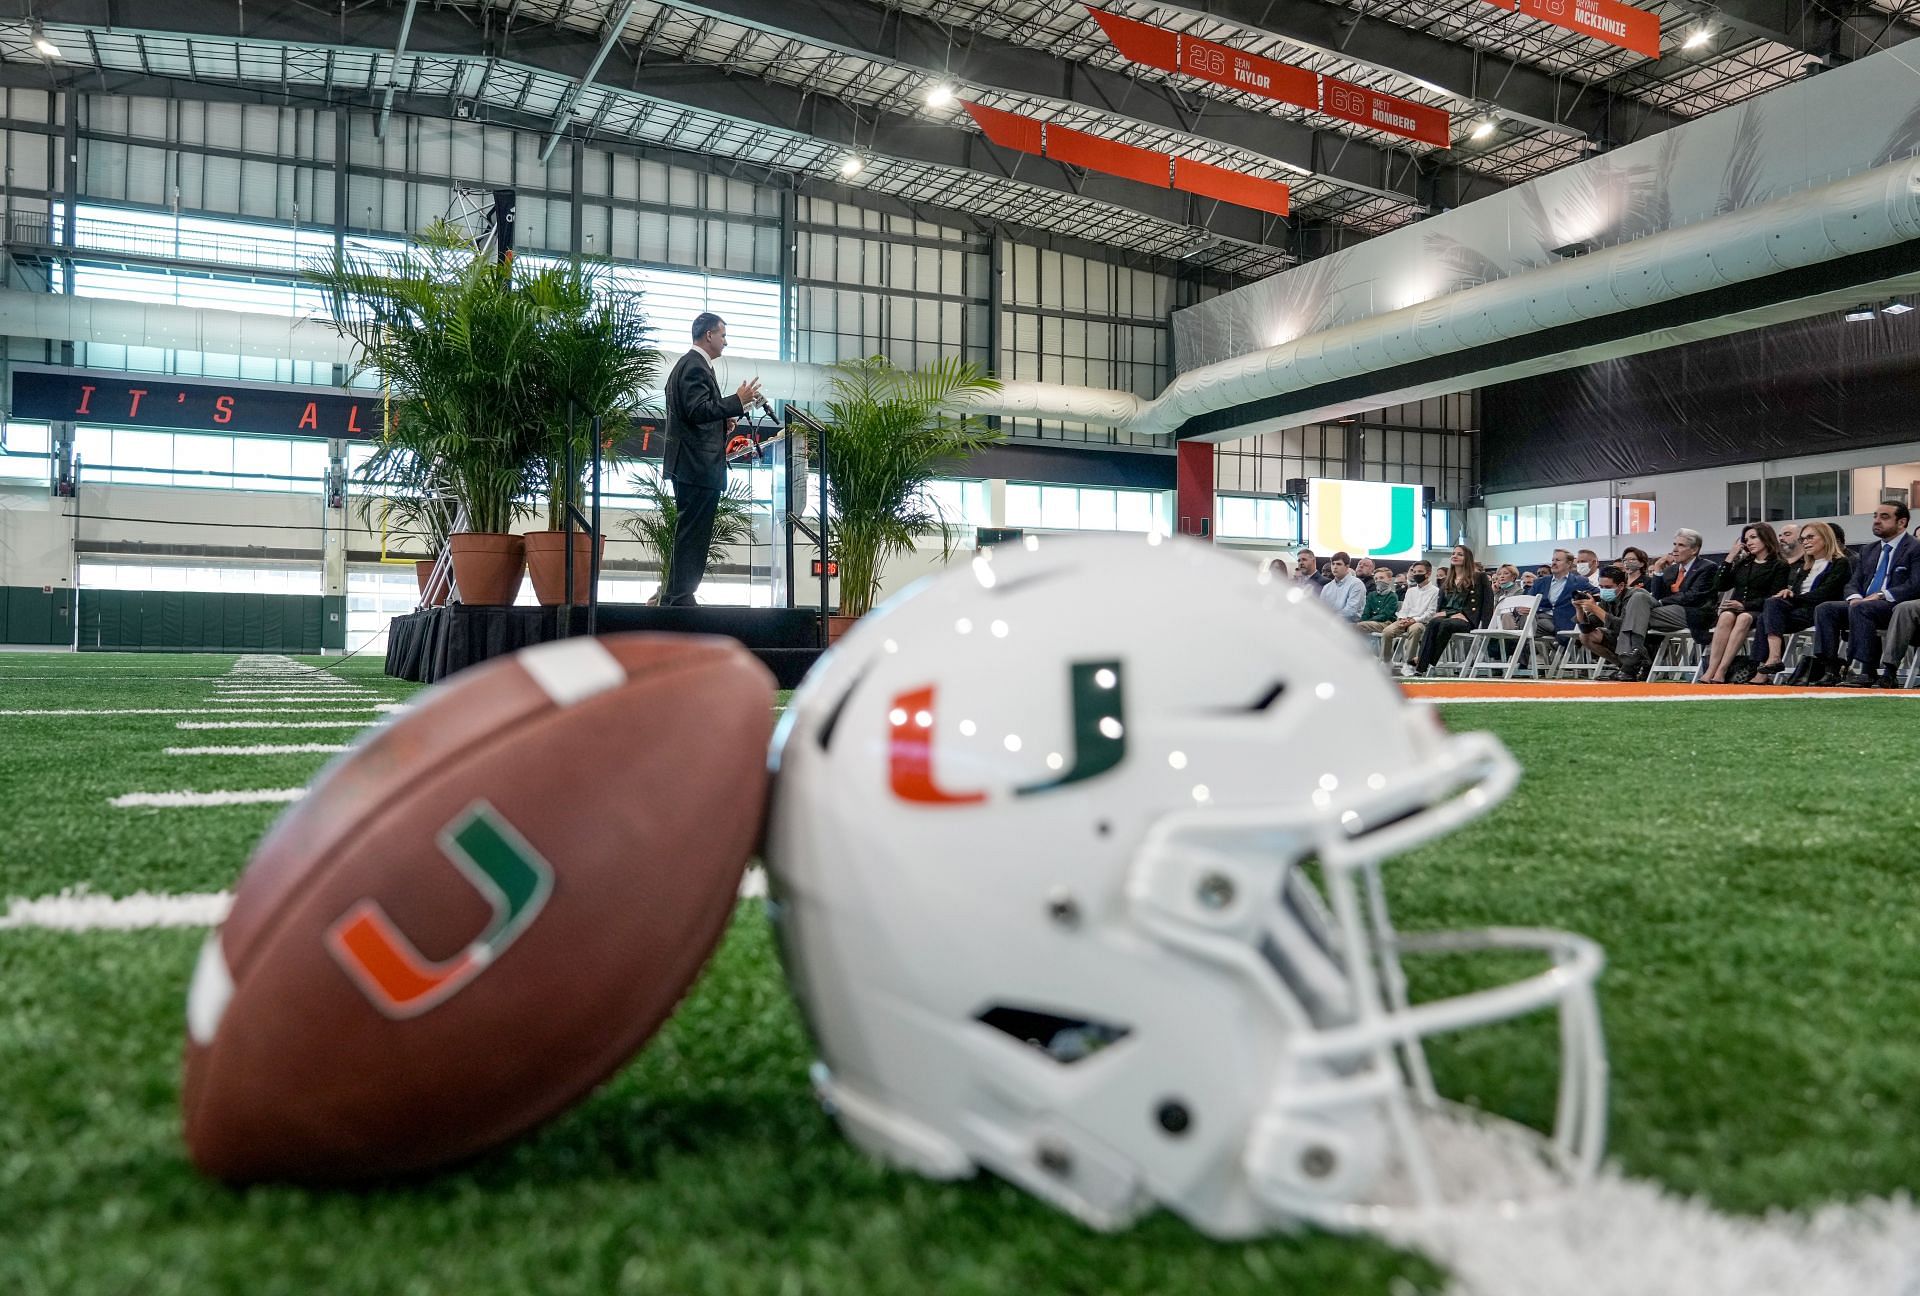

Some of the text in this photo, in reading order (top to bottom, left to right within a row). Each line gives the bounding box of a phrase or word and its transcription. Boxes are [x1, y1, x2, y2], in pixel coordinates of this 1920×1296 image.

[1574, 8, 1626, 38] MCKINNIE
[1189, 44, 1225, 76] 26
[1234, 57, 1251, 70] SEAN
[1234, 68, 1271, 89] TAYLOR
[1331, 86, 1365, 117] 66
[1372, 98, 1391, 111] BRETT
[1372, 109, 1416, 131] ROMBERG
[75, 386, 235, 424] IT'S
[1317, 480, 1414, 557] U
[887, 657, 1125, 808] U
[326, 798, 555, 1020] U
